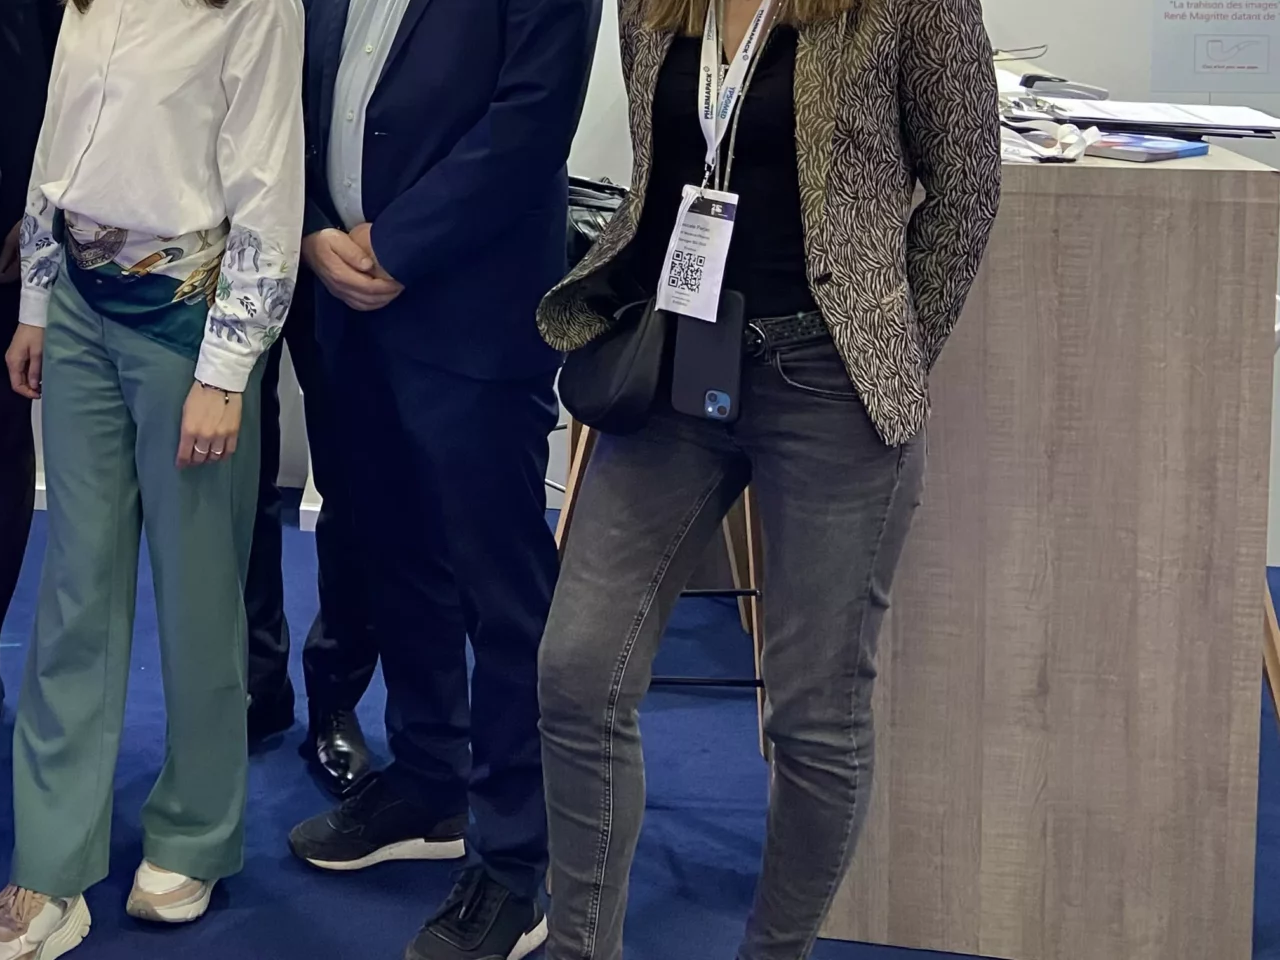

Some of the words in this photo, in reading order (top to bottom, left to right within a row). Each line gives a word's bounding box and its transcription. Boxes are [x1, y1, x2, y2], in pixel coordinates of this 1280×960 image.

[1186, 0, 1224, 9] trahison
[1226, 0, 1243, 9] des
[1163, 11, 1187, 20] René
[1189, 11, 1230, 23] Magritte
[1231, 11, 1262, 21] datant
[1263, 11, 1276, 21] de
[704, 73, 713, 121] PHARMAPACK
